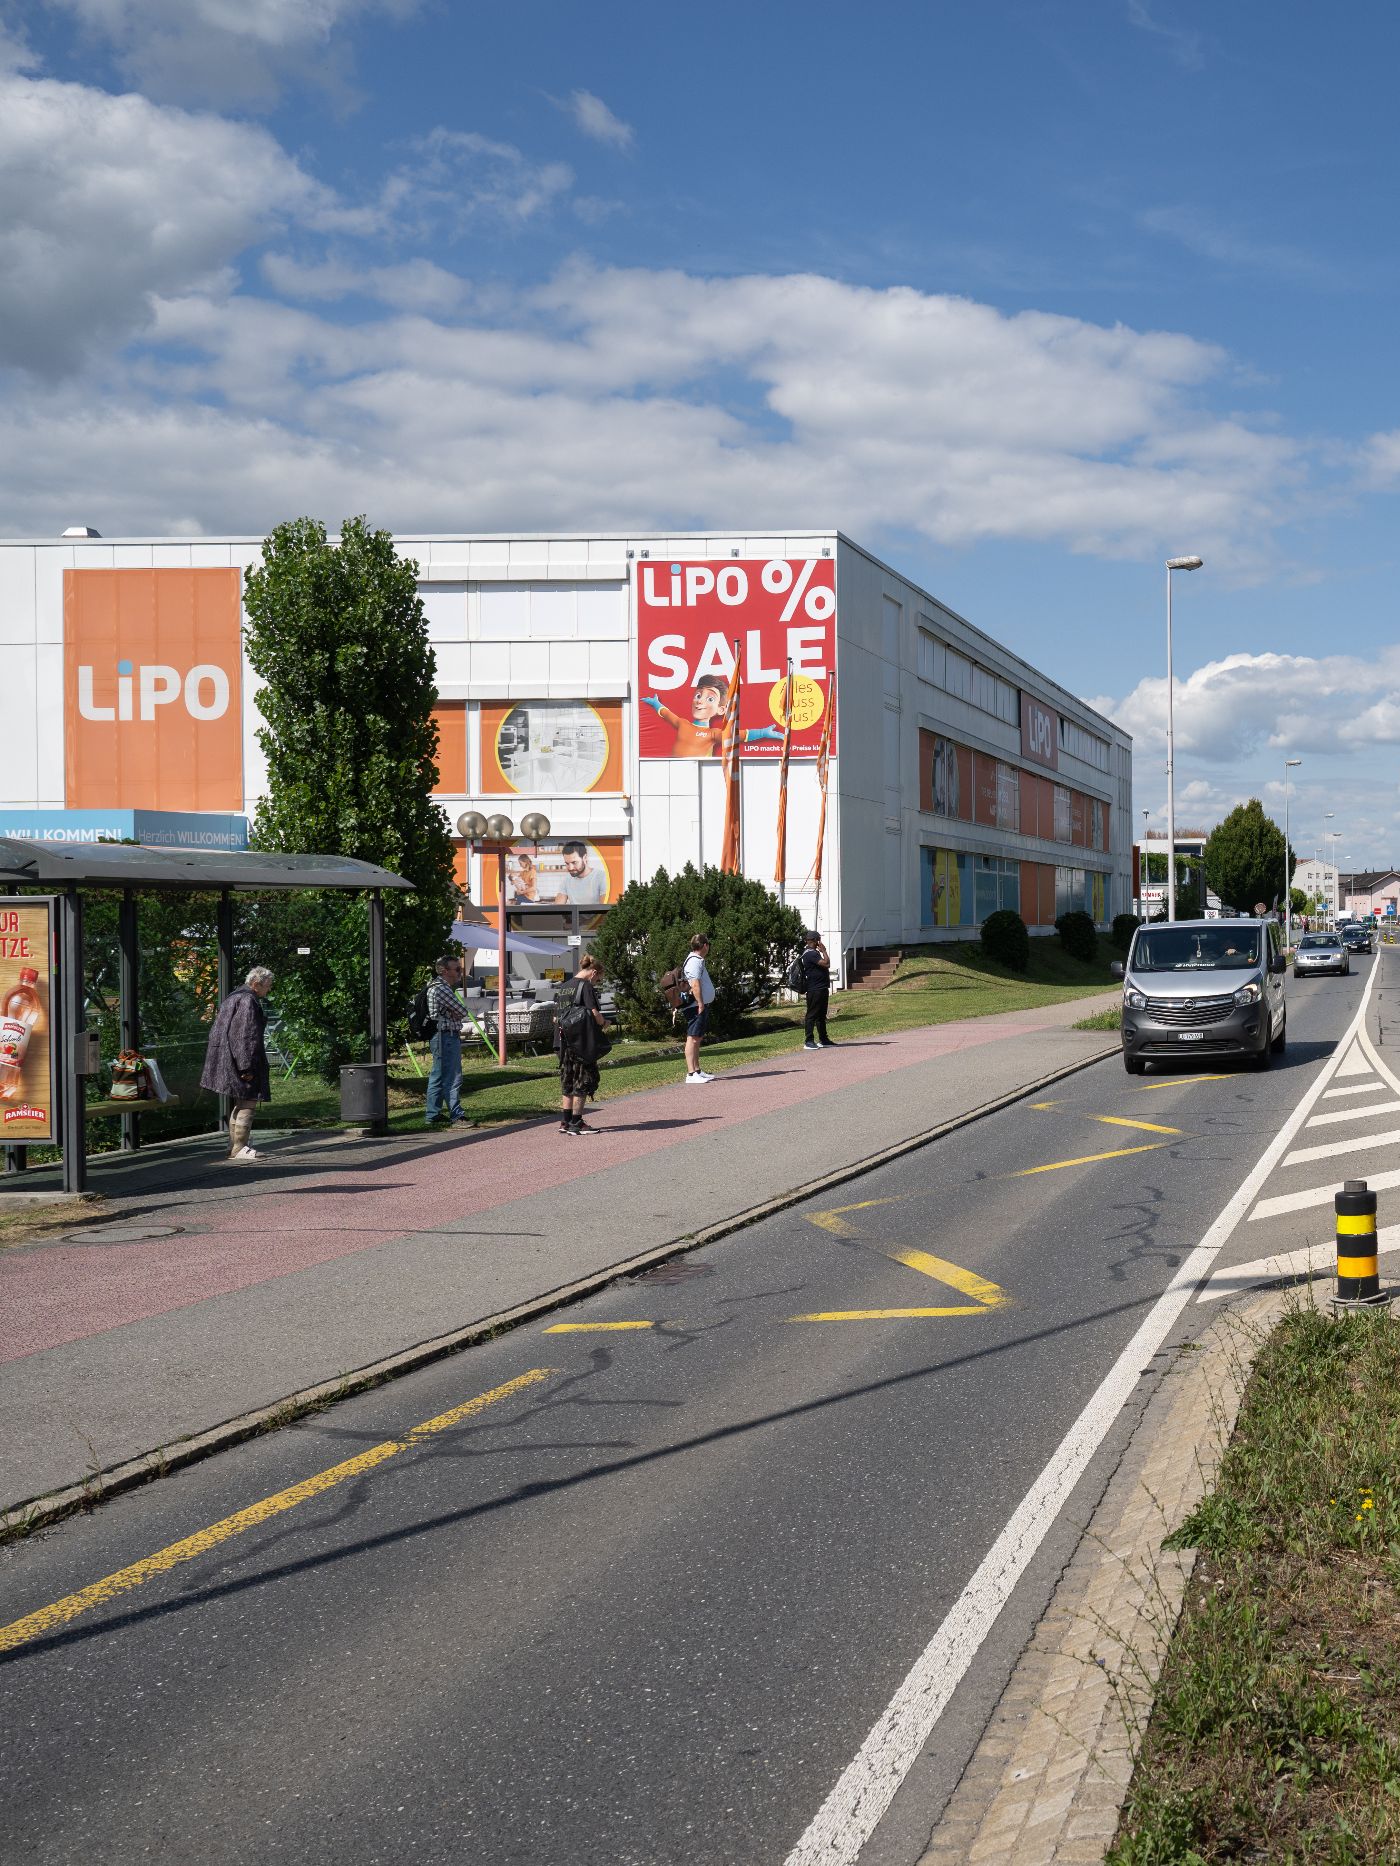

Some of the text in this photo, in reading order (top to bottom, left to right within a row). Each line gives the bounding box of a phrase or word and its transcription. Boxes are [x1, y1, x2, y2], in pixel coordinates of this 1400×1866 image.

[647, 626, 827, 691] SALE
[138, 828, 245, 846] Herzlich WILLKOMMEN!
